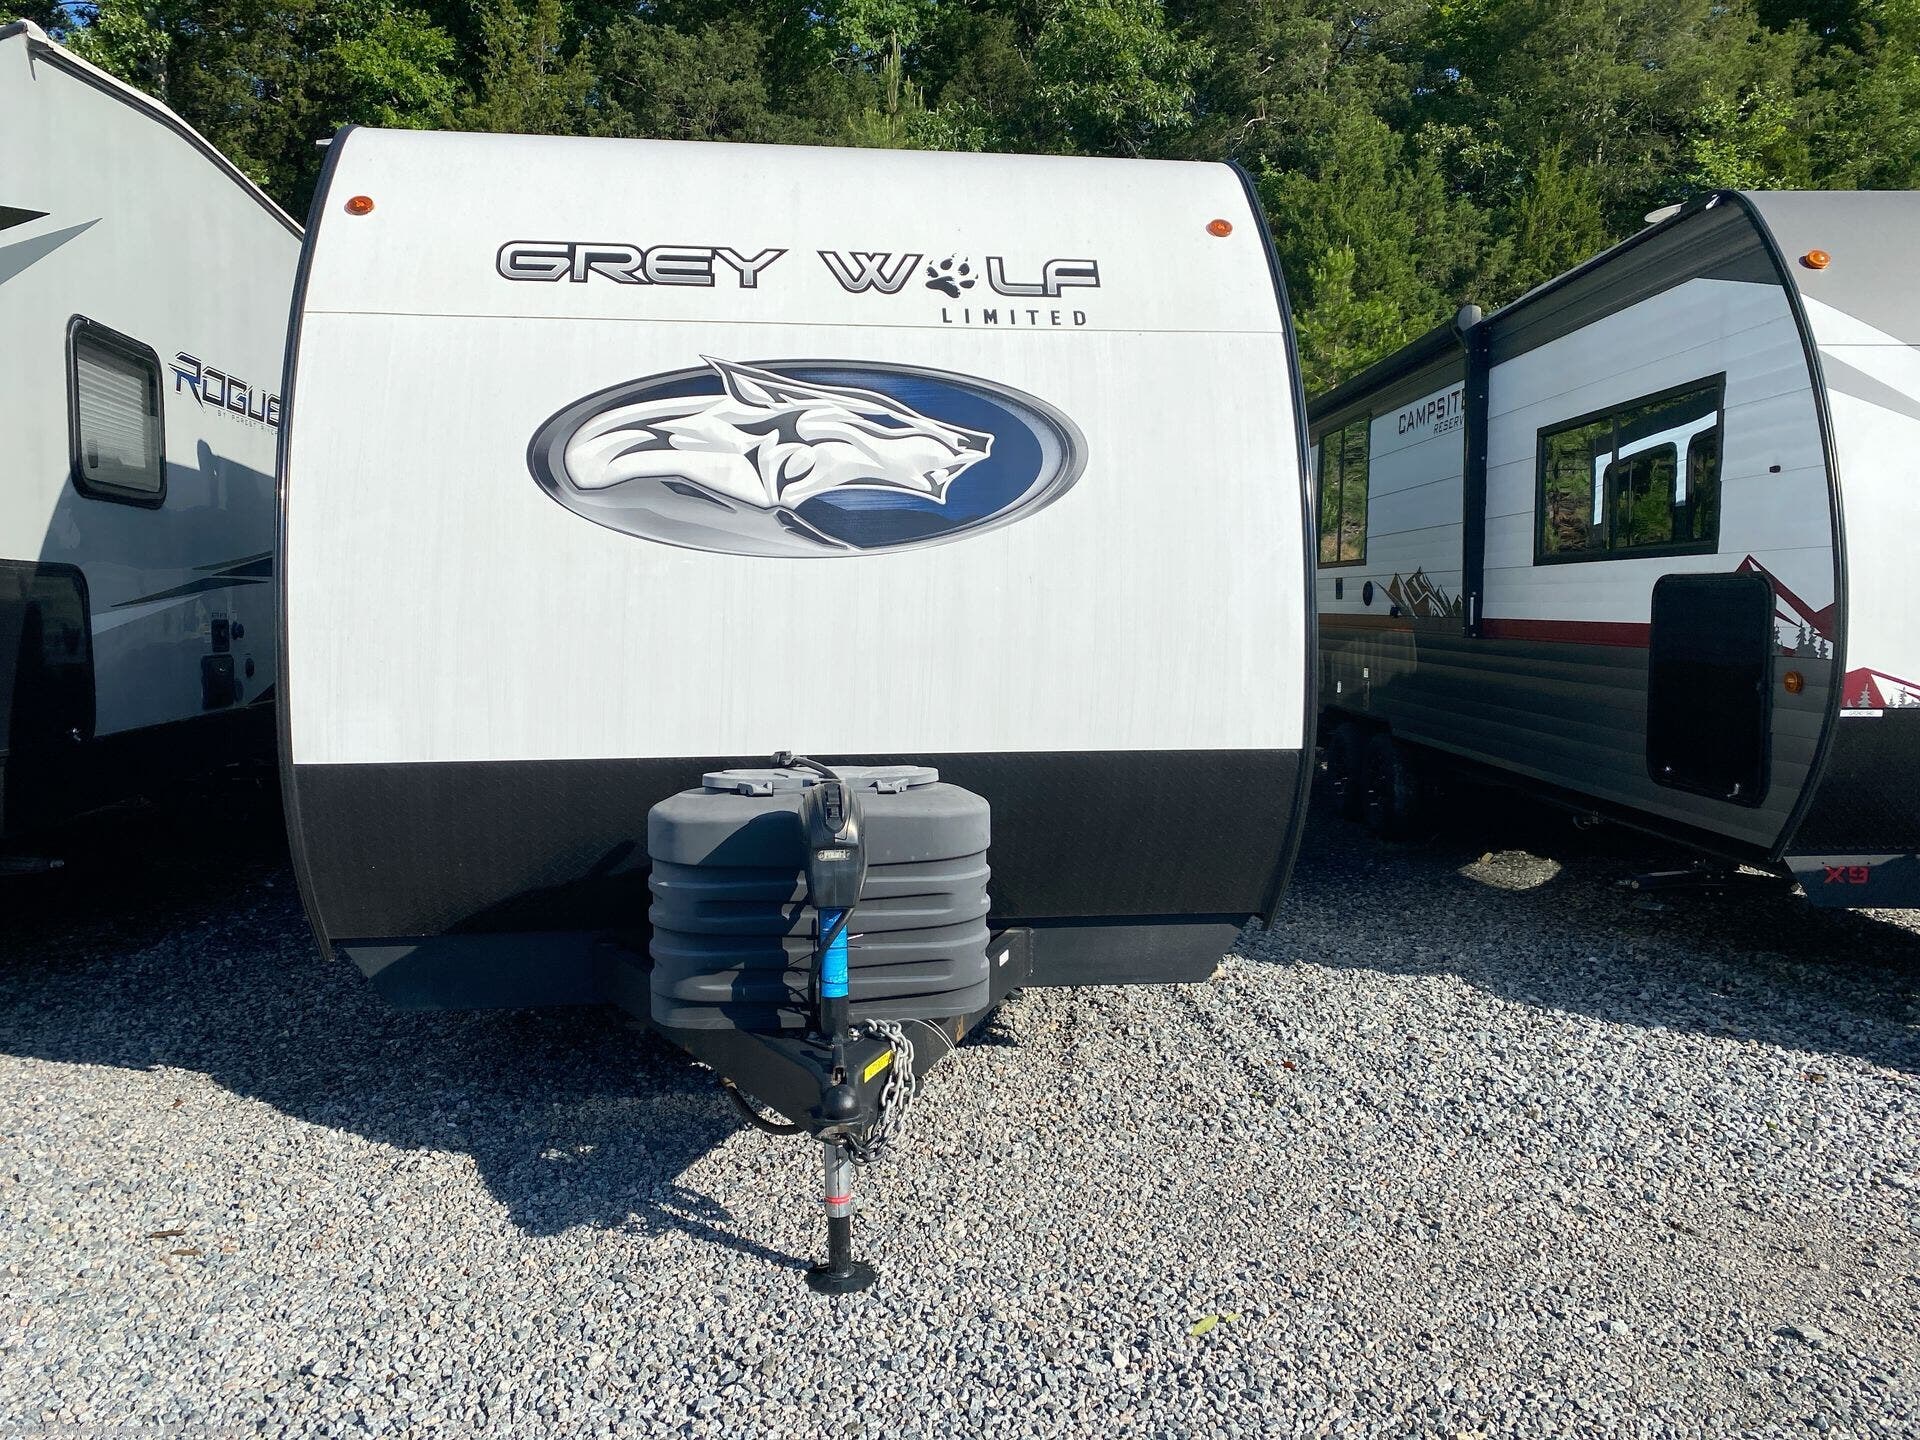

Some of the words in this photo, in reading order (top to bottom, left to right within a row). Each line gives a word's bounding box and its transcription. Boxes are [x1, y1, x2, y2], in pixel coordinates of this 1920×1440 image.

[496, 240, 790, 289] GREY
[941, 307, 1088, 327] LIMITED
[168, 351, 280, 430] ROGUE
[1433, 415, 1465, 435] RESERV
